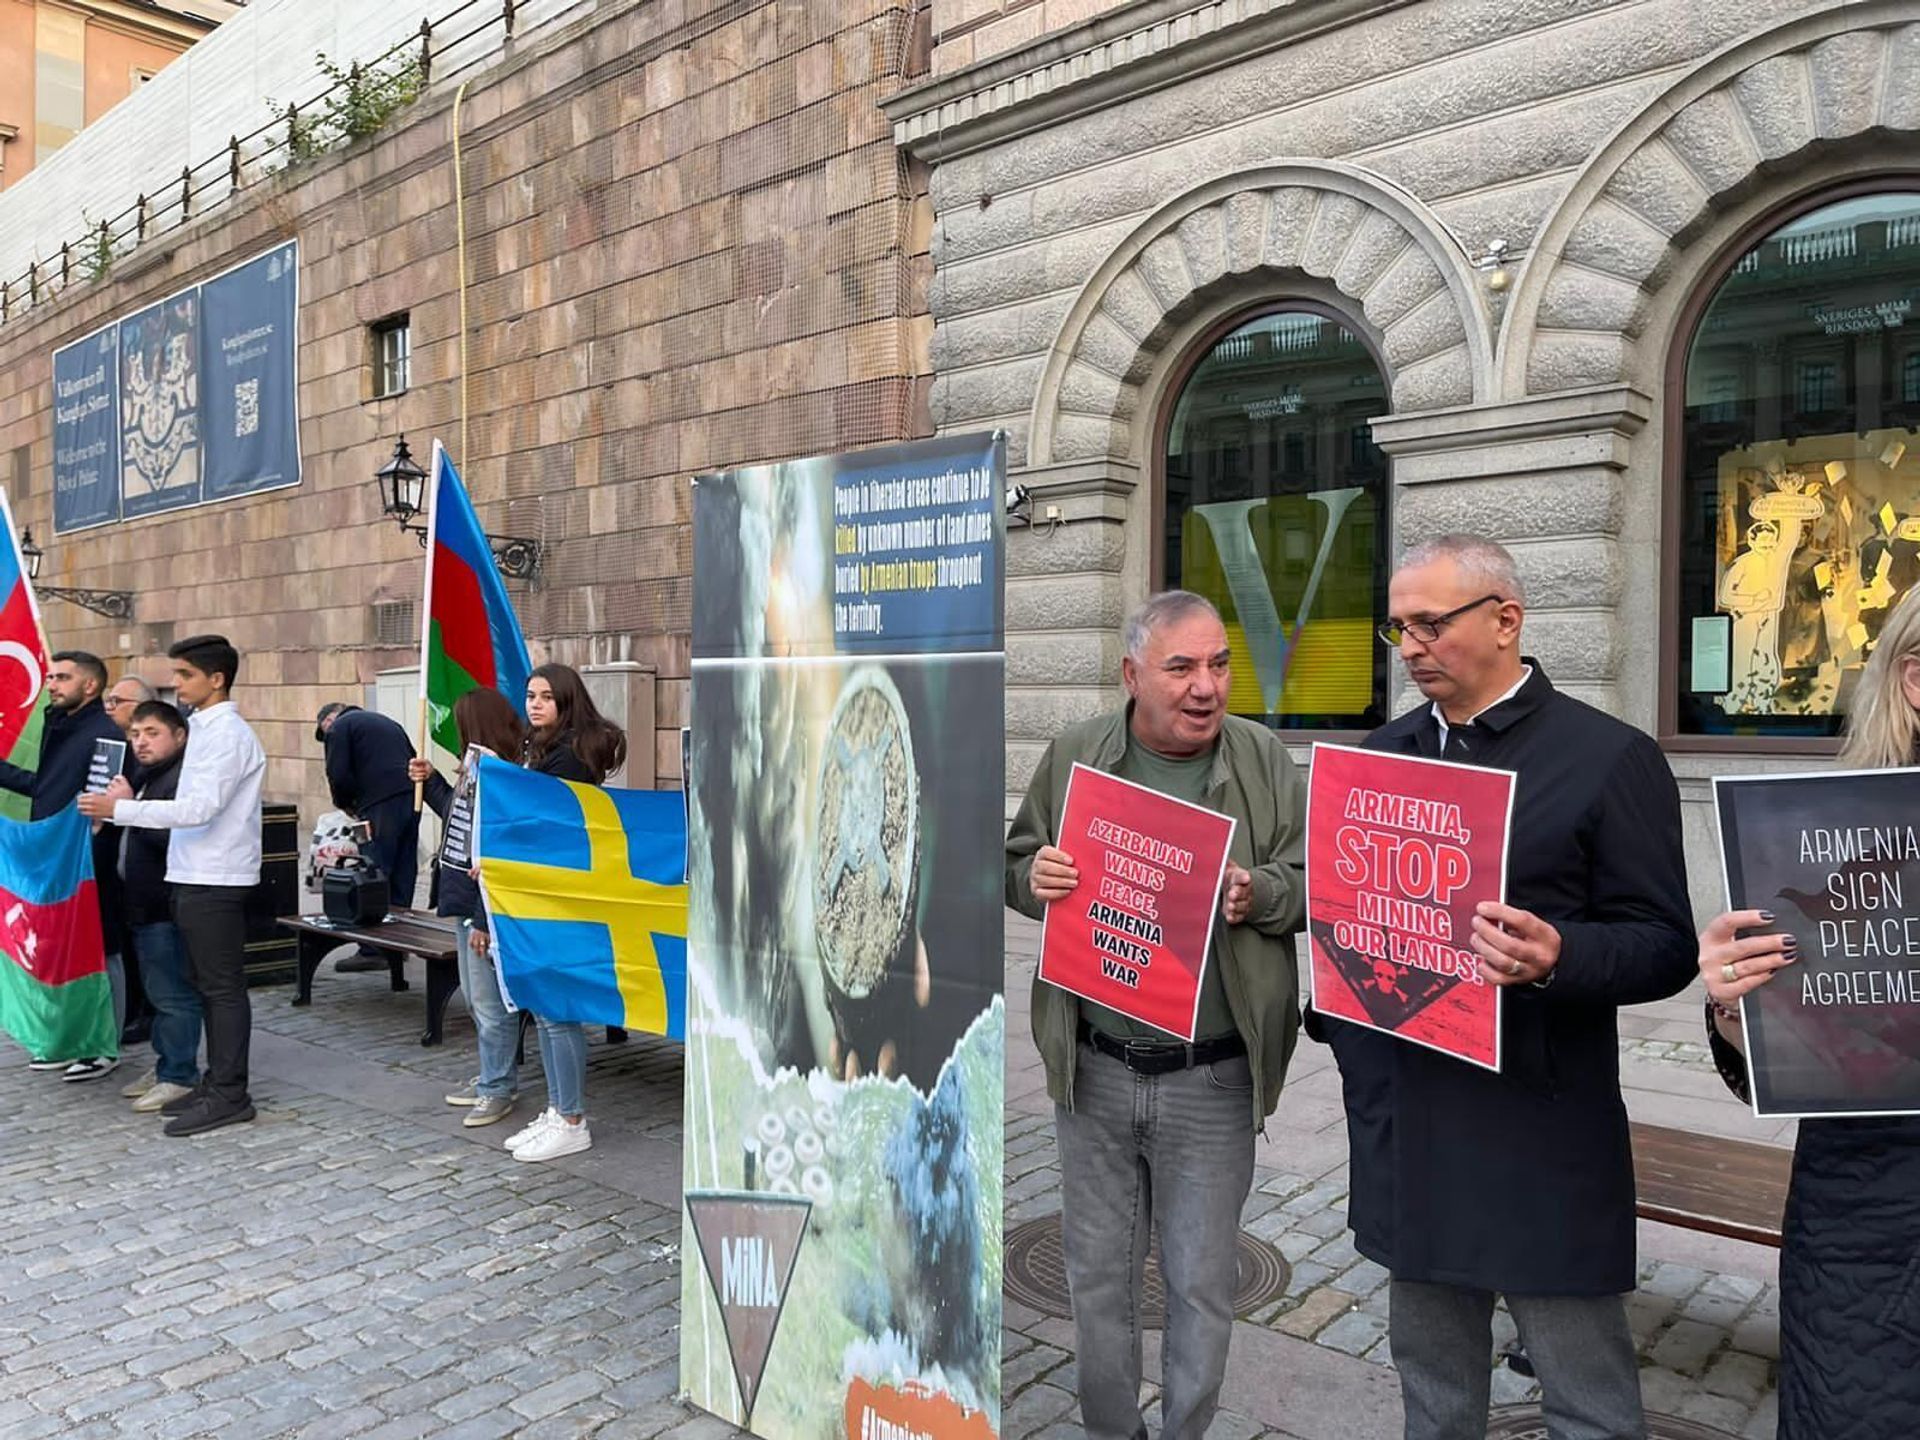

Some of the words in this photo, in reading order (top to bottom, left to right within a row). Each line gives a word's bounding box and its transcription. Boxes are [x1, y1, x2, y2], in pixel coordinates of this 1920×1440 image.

[1825, 317, 1881, 335] RIKSDAG
[835, 484, 860, 519] People
[861, 481, 869, 512] in
[870, 477, 906, 512] liberated
[907, 477, 930, 508] areas
[931, 468, 969, 506] continue
[970, 467, 980, 501] to
[980, 466, 990, 499] be
[835, 524, 857, 555] killed
[858, 523, 867, 557] by
[868, 521, 903, 552] unknown
[904, 515, 935, 549] number
[936, 513, 946, 546] of
[835, 562, 860, 594] buried
[860, 562, 869, 596] by
[871, 557, 909, 593] Armenian
[909, 558, 937, 593] troops
[937, 552, 982, 590] throughout
[835, 602, 848, 633] the
[848, 600, 884, 635] territory.
[1344, 787, 1470, 845] ARMENIA,
[1087, 817, 1194, 874] AZERBAIJAN
[1335, 825, 1471, 905] STOP
[1800, 825, 1920, 864] ARMENIA
[1105, 850, 1166, 892] WANTS
[1826, 871, 1903, 912] SIGN
[1101, 876, 1159, 920] PEACE,
[1357, 891, 1452, 941] MINING
[1088, 901, 1162, 946] ARMENIA
[1819, 918, 1920, 958] PEACE
[1093, 929, 1151, 967] WANTS
[1334, 920, 1387, 959] OUR
[1390, 935, 1484, 986] LANDS!
[1102, 957, 1139, 988] WAR
